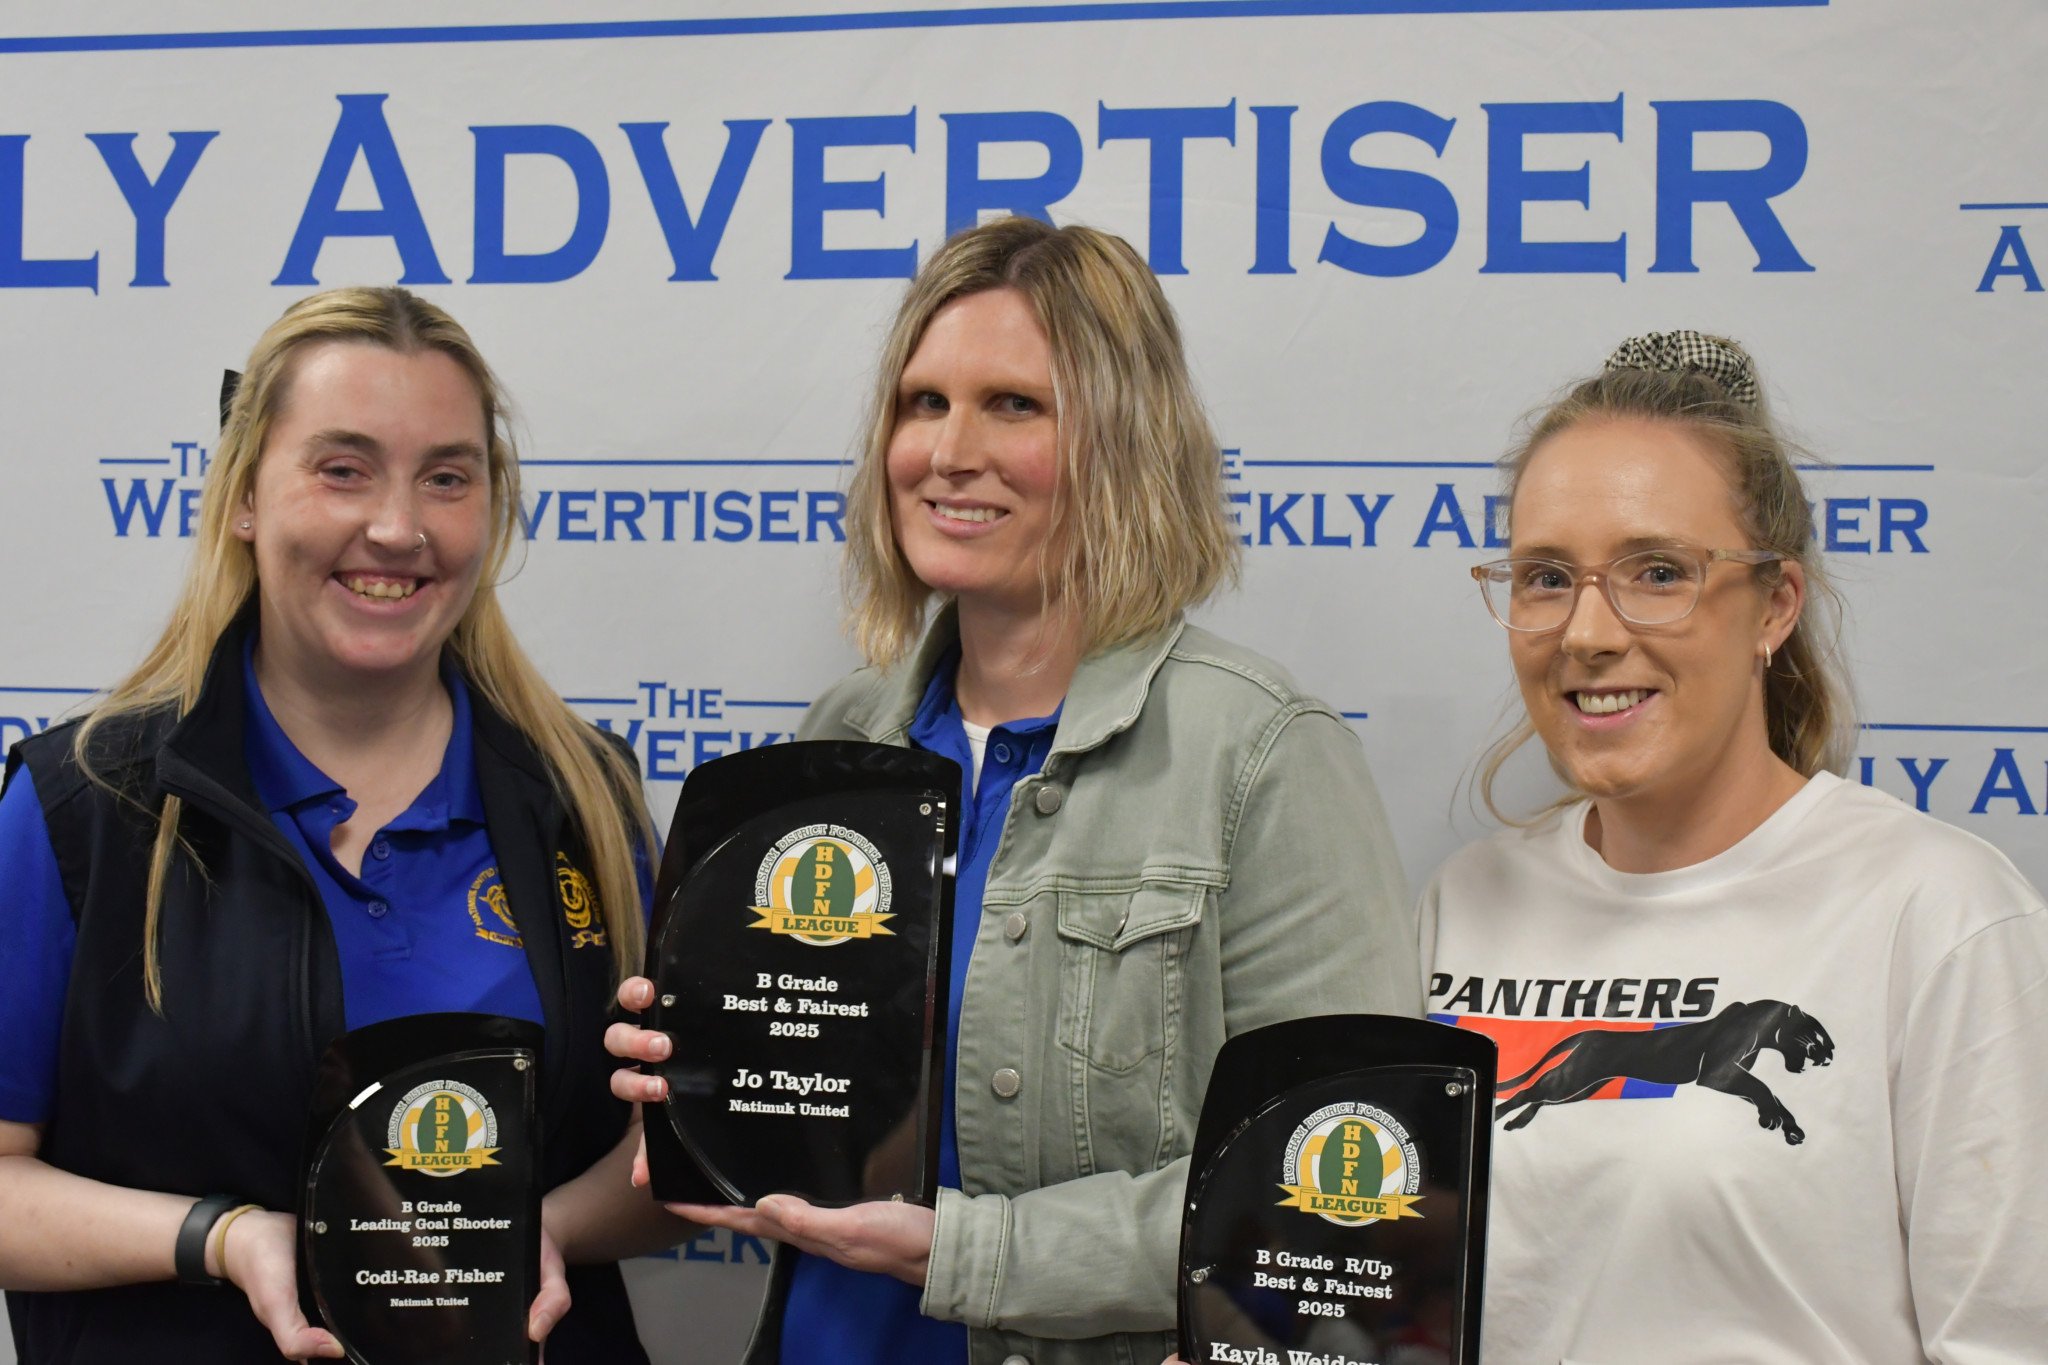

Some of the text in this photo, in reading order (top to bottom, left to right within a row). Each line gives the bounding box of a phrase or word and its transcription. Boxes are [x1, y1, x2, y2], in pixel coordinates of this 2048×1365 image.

[271, 91, 1816, 286] ADVERTISER
[638, 681, 722, 719] THE
[755, 847, 780, 906] HORSHAM
[775, 824, 827, 851] DISTRICT
[829, 825, 882, 864] FOOTBALL
[783, 918, 858, 933] LEAGUE
[756, 973, 838, 992] B Grade
[1430, 973, 1719, 1018] PANTHERS
[723, 995, 869, 1017] Best & Fairest
[769, 1022, 820, 1038] 2025
[732, 1069, 850, 1095] Jo Taylor
[388, 1101, 408, 1148] HORSHAM
[402, 1080, 445, 1105] DISTRICT
[445, 1080, 488, 1109] FOOTBALL
[729, 1099, 850, 1118] Natimuk United
[1283, 1124, 1307, 1184] HORSHAM
[1303, 1102, 1355, 1130] DISTRICT
[1356, 1103, 1409, 1144] FOOTBALL
[411, 1155, 472, 1166] LEAGUE
[402, 1201, 461, 1213] B Grade
[1310, 1197, 1387, 1215] LEAGUE
[350, 1217, 511, 1233] Leading Goal Shooter
[412, 1236, 449, 1247] 2025
[1256, 1249, 1393, 1280] B Grade R/Up
[356, 1269, 505, 1284] Codi-Rae Fisher
[1254, 1272, 1392, 1300] Best & Fairest
[390, 1297, 469, 1307] Natimuk United
[1298, 1300, 1346, 1318] 2025
[1210, 1342, 1280, 1365] Kayla
